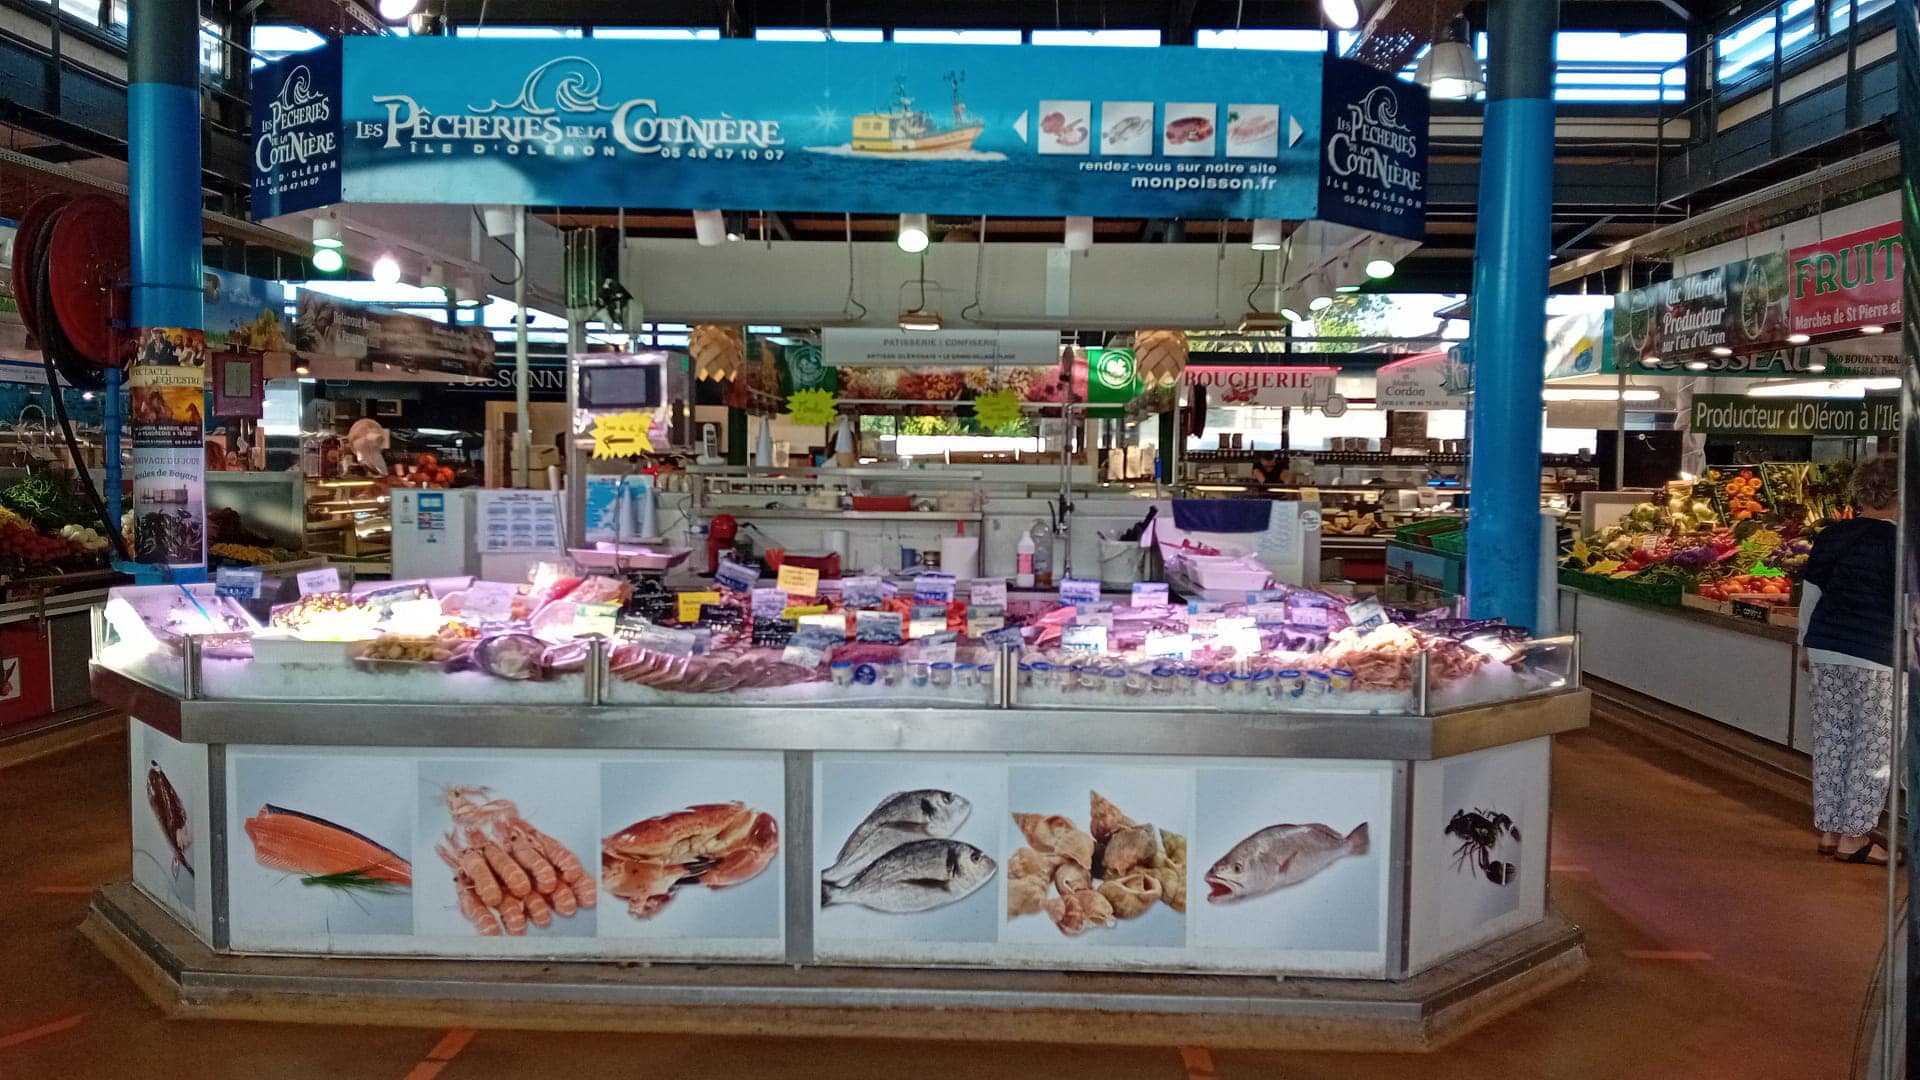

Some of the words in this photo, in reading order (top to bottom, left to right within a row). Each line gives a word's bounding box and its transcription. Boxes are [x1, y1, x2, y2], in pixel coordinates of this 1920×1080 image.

[356, 121, 384, 140] LES
[373, 95, 563, 149] PÊCHERIES
[611, 98, 785, 153] COTINIÈRE
[473, 144, 616, 157] D'OLÉRON
[660, 148, 681, 159] 05
[687, 149, 708, 160] 46
[714, 150, 734, 160] 47
[741, 150, 758, 161] 10
[765, 150, 785, 161] 07
[1079, 161, 1172, 173] rendez-vous
[1176, 163, 1200, 173] sur
[1205, 162, 1244, 174] notre
[1248, 162, 1277, 174] site
[1131, 175, 1277, 191] monpoisson.fr
[1663, 306, 1726, 336] Producteur
[1795, 311, 1832, 331] Marchés
[1833, 308, 1844, 325] de
[1847, 304, 1857, 322] St
[1859, 302, 1889, 320] Pierre
[1184, 371, 1313, 388] BOUCHERIE
[1697, 402, 1785, 430] Producteur
[1788, 402, 1854, 430] d'Oléron
[1859, 402, 1869, 430] à
